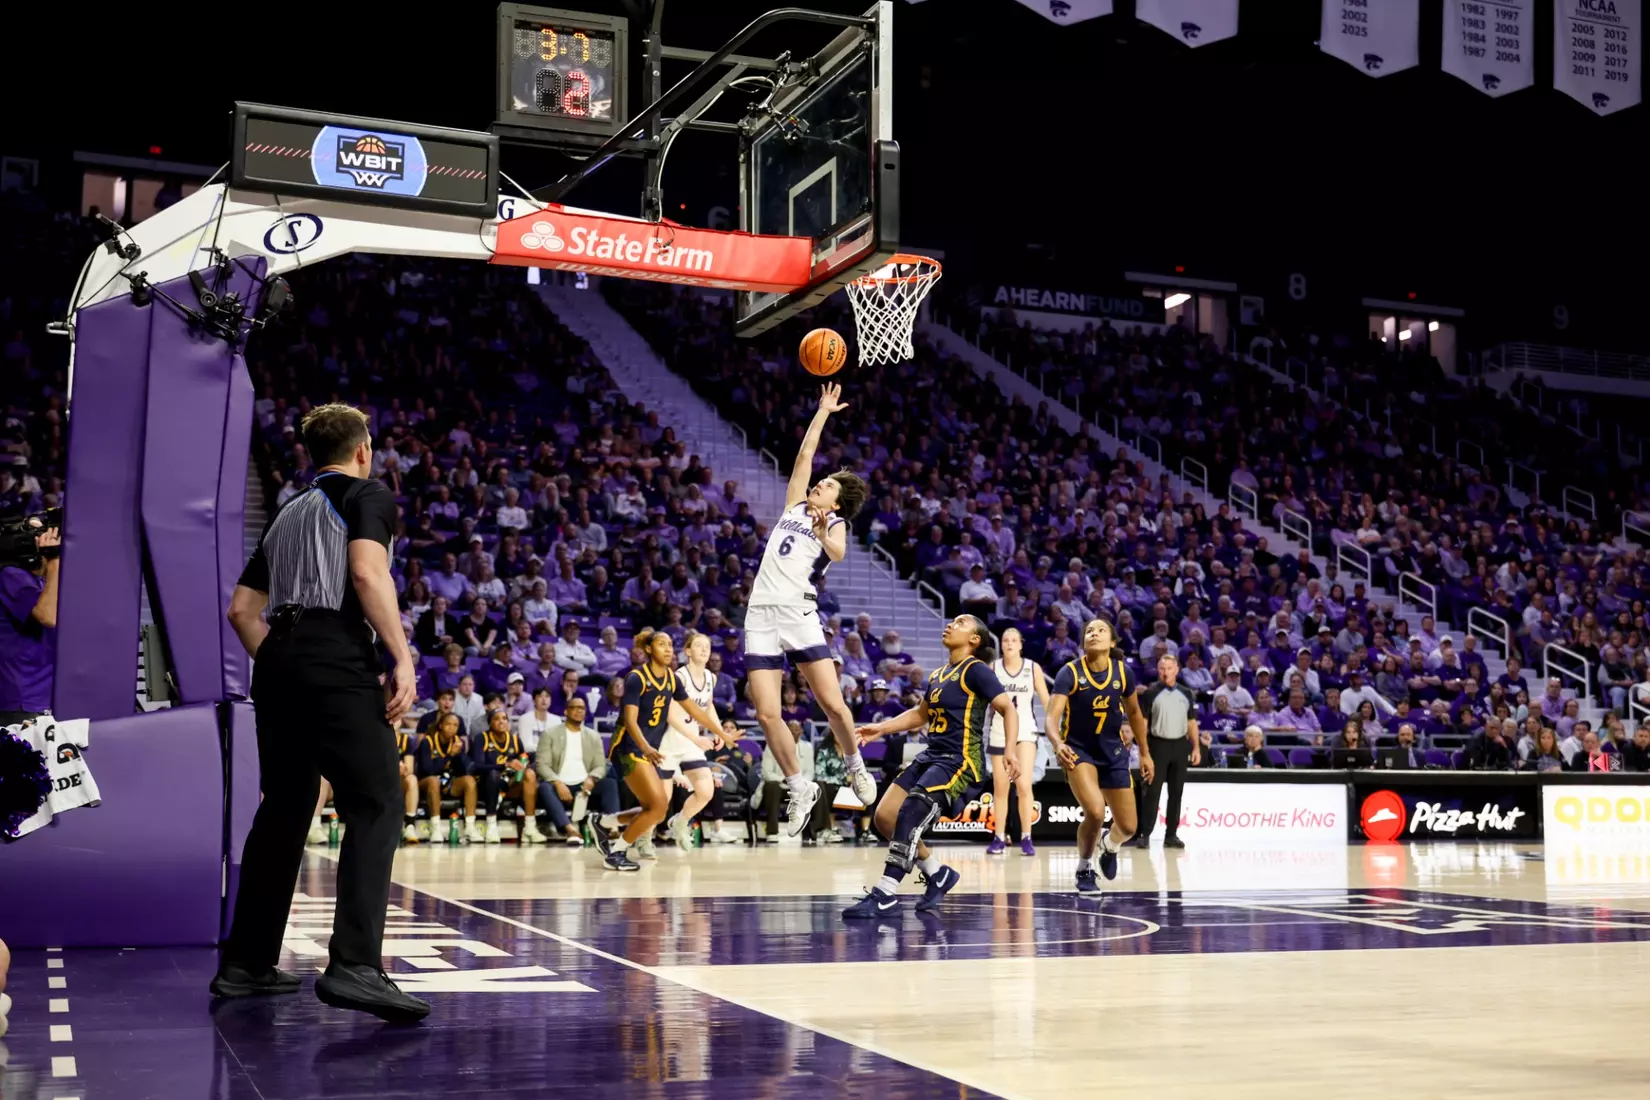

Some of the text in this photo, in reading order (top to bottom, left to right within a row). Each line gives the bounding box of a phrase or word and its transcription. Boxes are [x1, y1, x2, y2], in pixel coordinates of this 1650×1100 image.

[1341, 9, 1368, 23] 2002
[1462, 3, 1519, 21] 1982 1997
[1579, 0, 1616, 15] NCAA
[1341, 23, 1368, 37] 2025
[1462, 16, 1520, 36] 1983 2002
[1571, 22, 1627, 41] 2005 2012
[1462, 31, 1520, 50] 1984 2003
[1571, 36, 1628, 55] 2008 2016
[1463, 45, 1521, 63] 1987 2004
[1571, 50, 1628, 68] 2009 2017
[1572, 64, 1629, 82] 2011 2019
[339, 151, 402, 171] WBIT
[1287, 272, 1308, 300] 8
[1552, 304, 1570, 330] 9
[778, 534, 795, 556] 6
[1092, 695, 1110, 710] Cal
[648, 707, 662, 727] 3
[927, 708, 949, 734] 25
[1092, 711, 1108, 735] 7
[1048, 805, 1086, 823] SINC
[1194, 808, 1289, 827] SMOOTHIE
[1409, 802, 1526, 833] Pizza Hut
[1553, 796, 1650, 832] QDO
